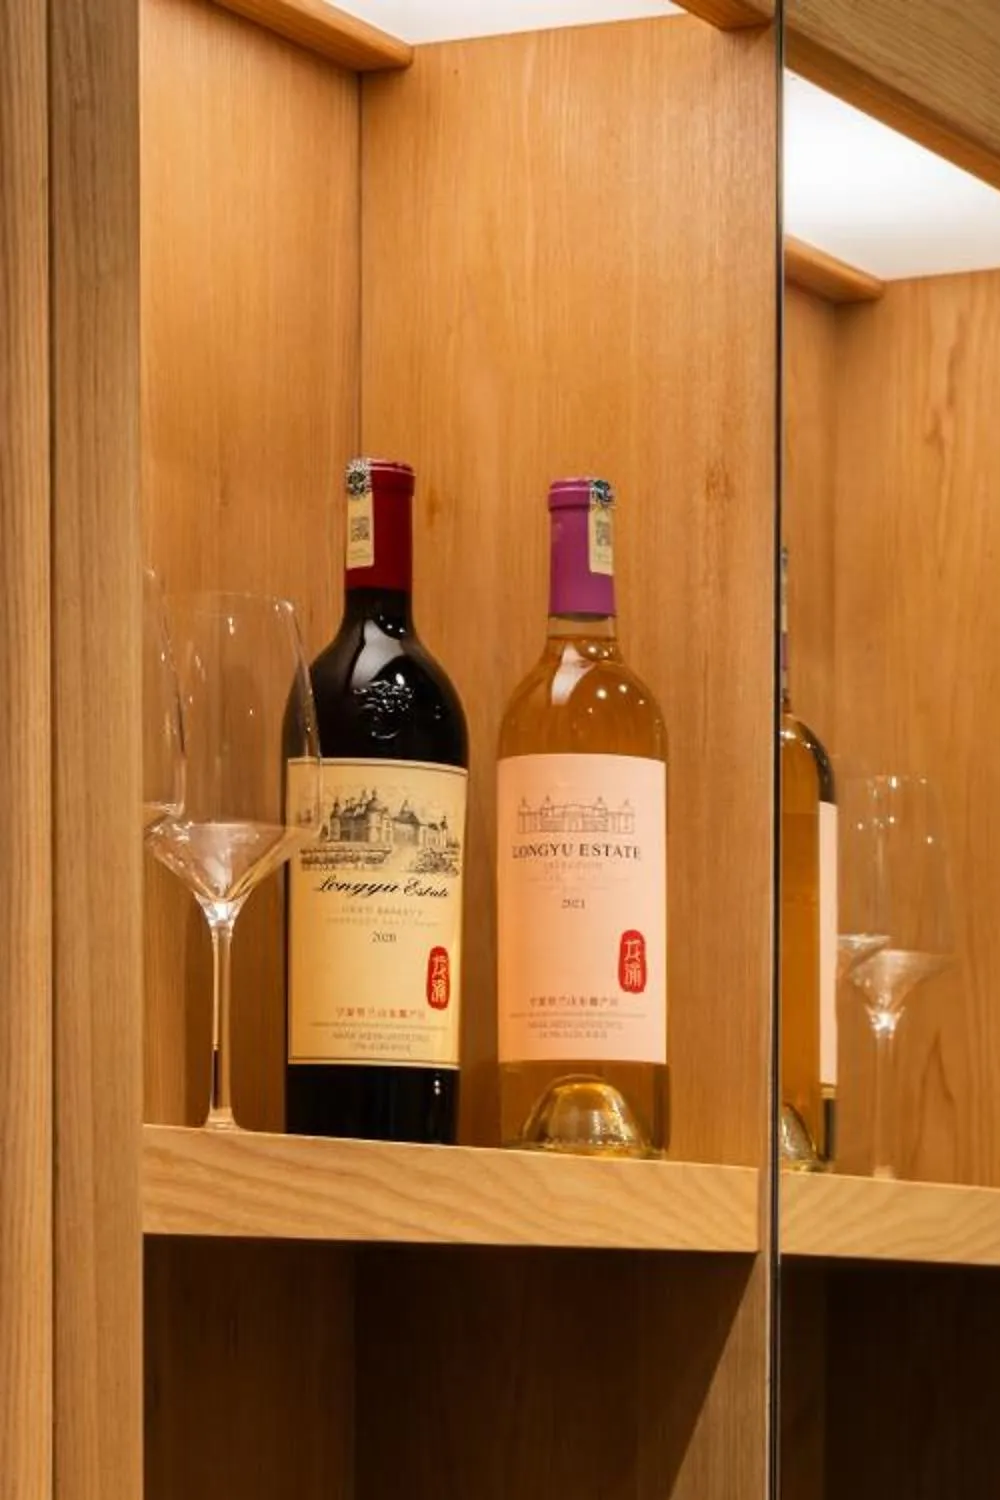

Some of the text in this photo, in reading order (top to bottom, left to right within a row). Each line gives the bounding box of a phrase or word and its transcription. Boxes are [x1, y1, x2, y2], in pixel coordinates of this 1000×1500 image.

[512, 843, 641, 860] LONGYU ESTATE
[315, 873, 400, 897] Longyu
